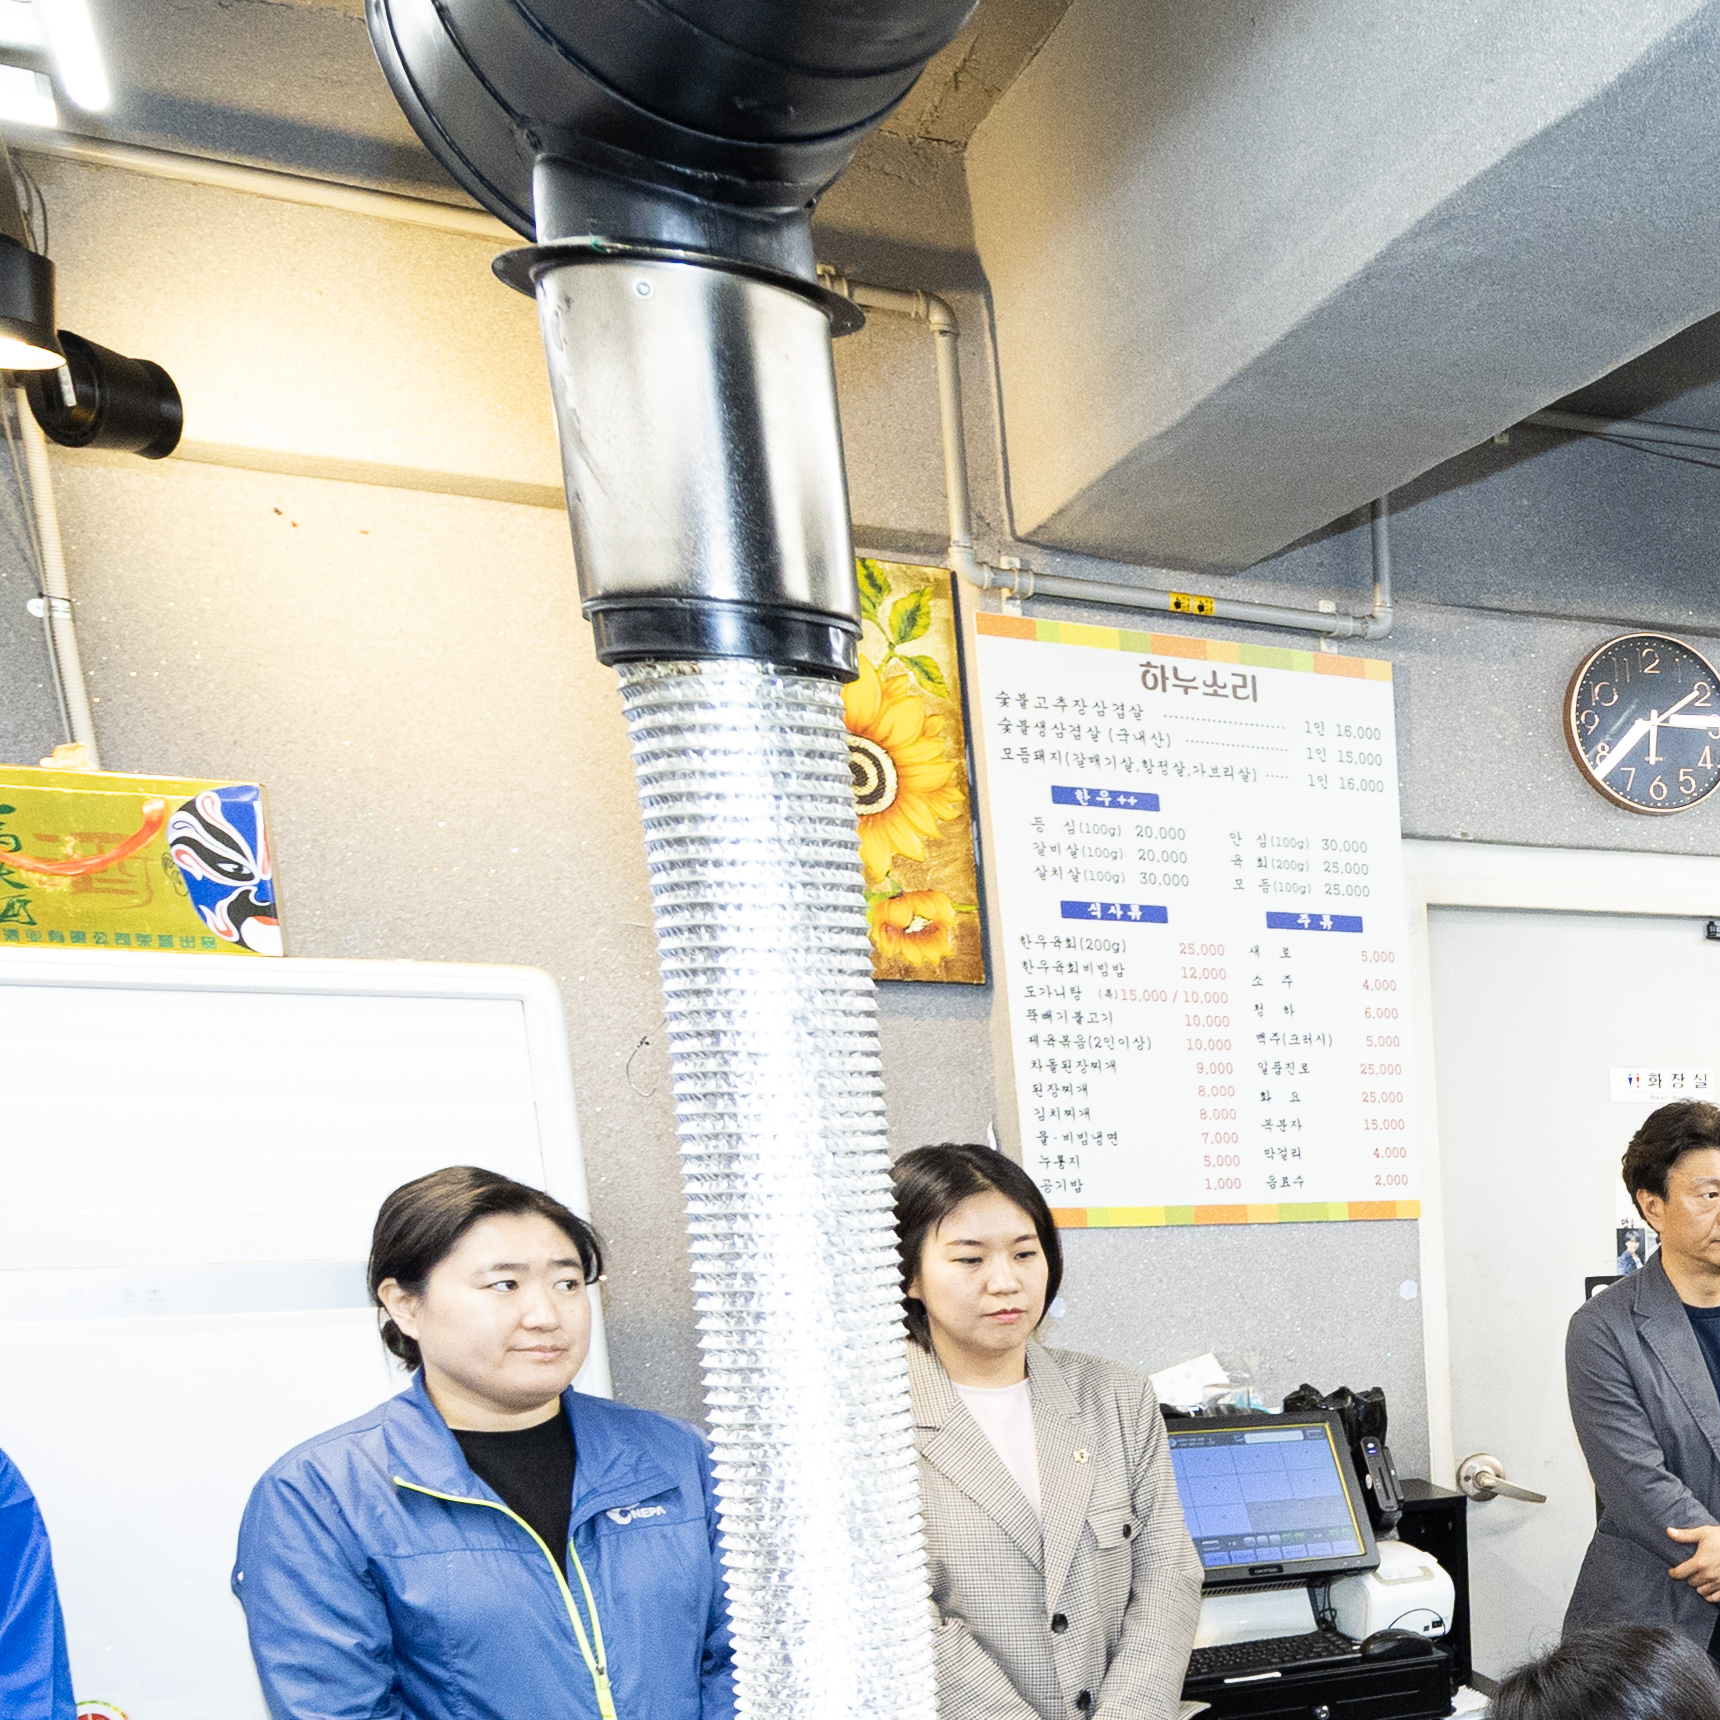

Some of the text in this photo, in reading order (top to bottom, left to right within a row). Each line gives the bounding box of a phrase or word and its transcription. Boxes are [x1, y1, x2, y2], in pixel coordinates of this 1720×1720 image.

[1636, 647, 1661, 673] 12
[1139, 661, 1258, 703] 하누소리
[1589, 681, 1618, 707] 10
[1694, 681, 1711, 707] 2
[1581, 709, 1599, 736] 9
[1697, 745, 1713, 770] 4
[1620, 767, 1636, 791] 7
[1649, 775, 1668, 800] 6
[1679, 768, 1696, 794] 5
[630, 1505, 667, 1519] NEPA
